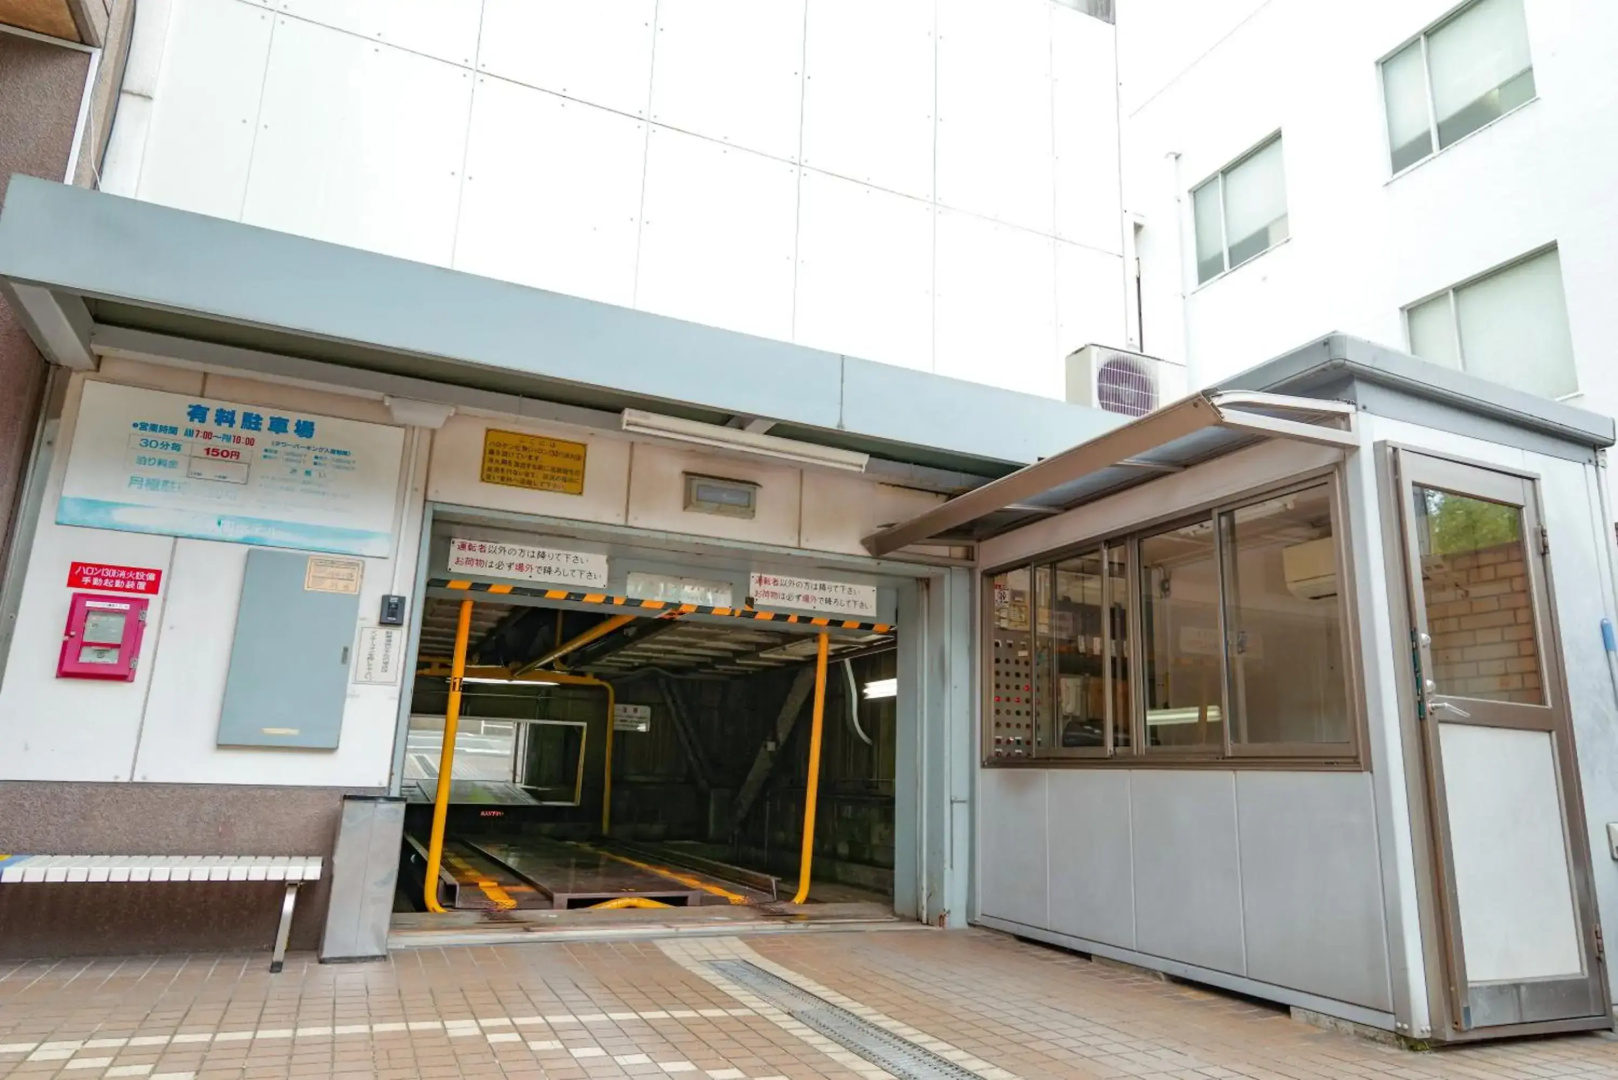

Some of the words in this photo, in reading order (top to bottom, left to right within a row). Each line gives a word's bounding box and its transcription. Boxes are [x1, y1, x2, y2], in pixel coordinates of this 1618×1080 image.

[139, 422, 179, 435] 営業時間
[187, 404, 315, 439] 有料駐車場
[139, 438, 182, 452] 30分毎
[204, 447, 241, 460] 150円
[457, 541, 589, 565] 運転者以外の方は降りて下さい
[454, 556, 602, 581] お荷物は必ず場外で降ろして下さい
[81, 576, 147, 590] 手動起動装置
[754, 575, 861, 596] 運転者以外の方は降りて下さい
[754, 590, 873, 610] お荷物は必ず場外で降ろして下さい
